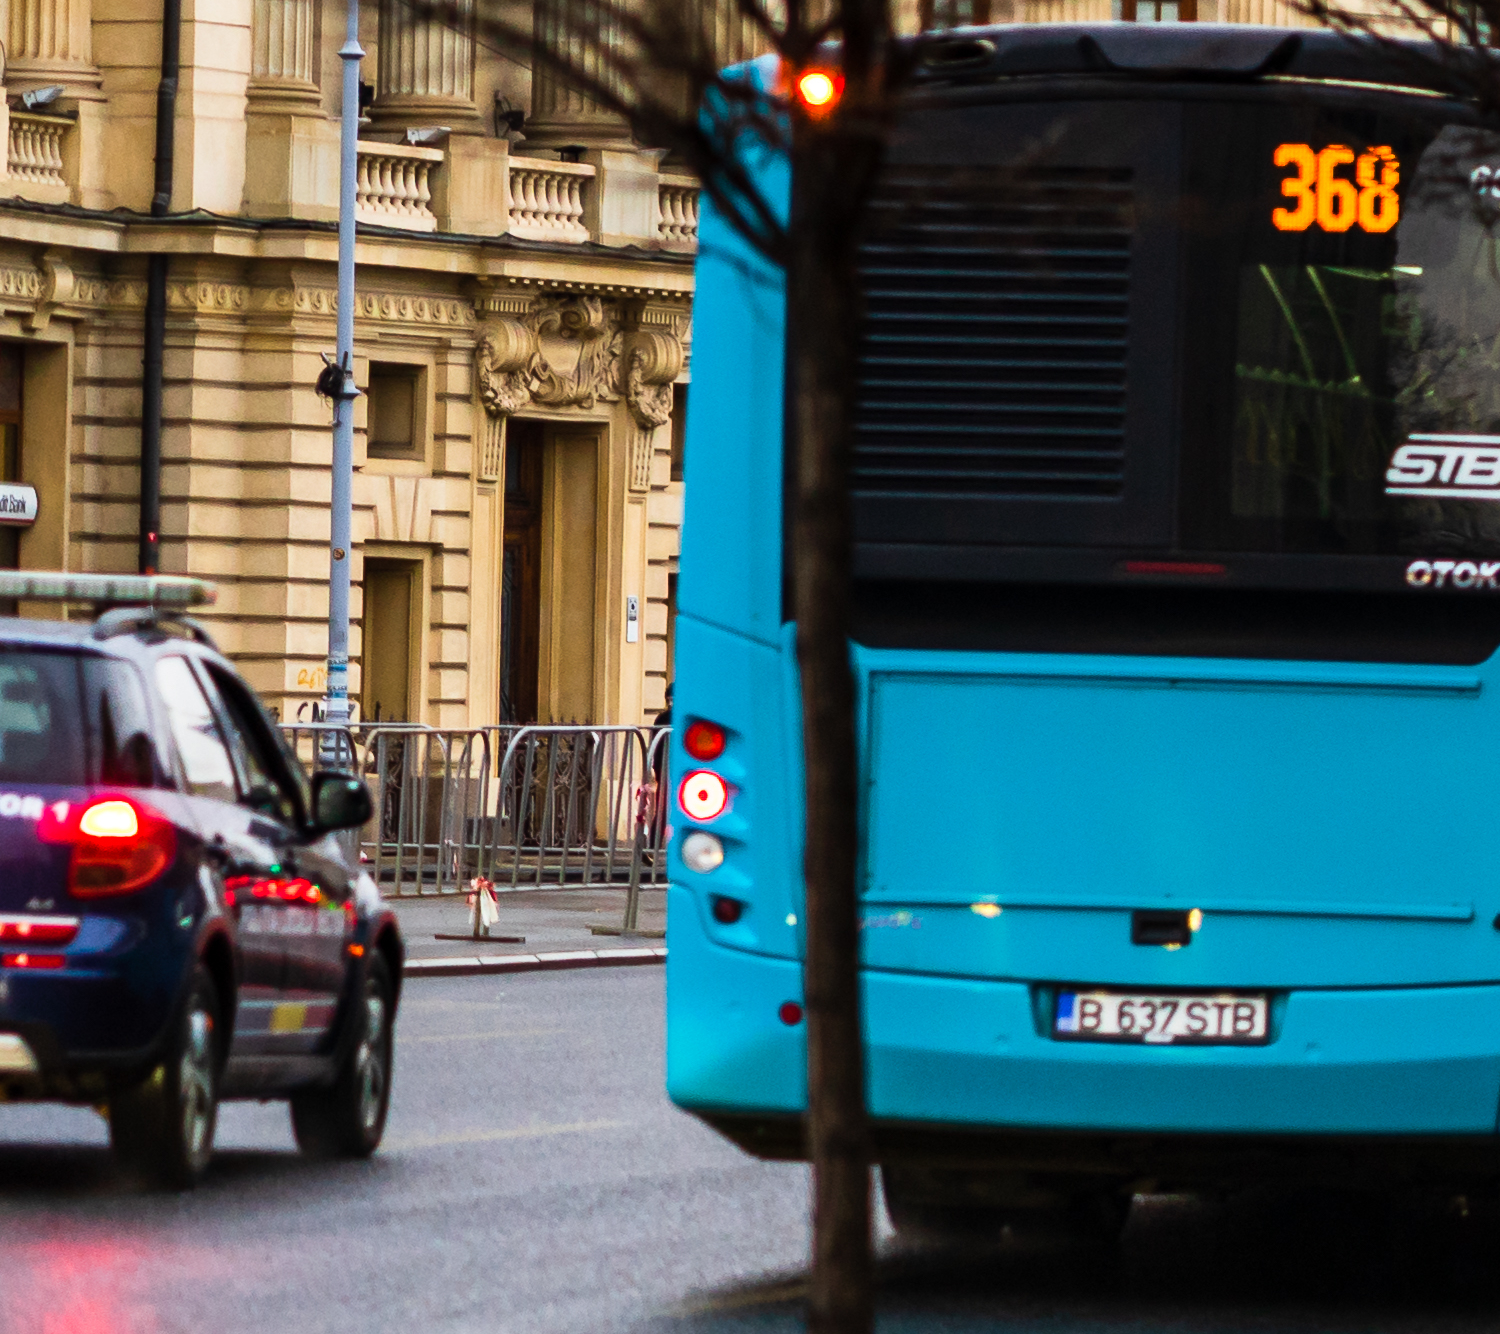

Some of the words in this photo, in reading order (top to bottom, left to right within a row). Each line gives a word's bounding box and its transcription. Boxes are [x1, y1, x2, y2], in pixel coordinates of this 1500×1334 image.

[1272, 144, 1399, 233] 368
[1080, 999, 1102, 1030] B
[1117, 1000, 1180, 1034] 637
[1186, 1001, 1256, 1035] STB
